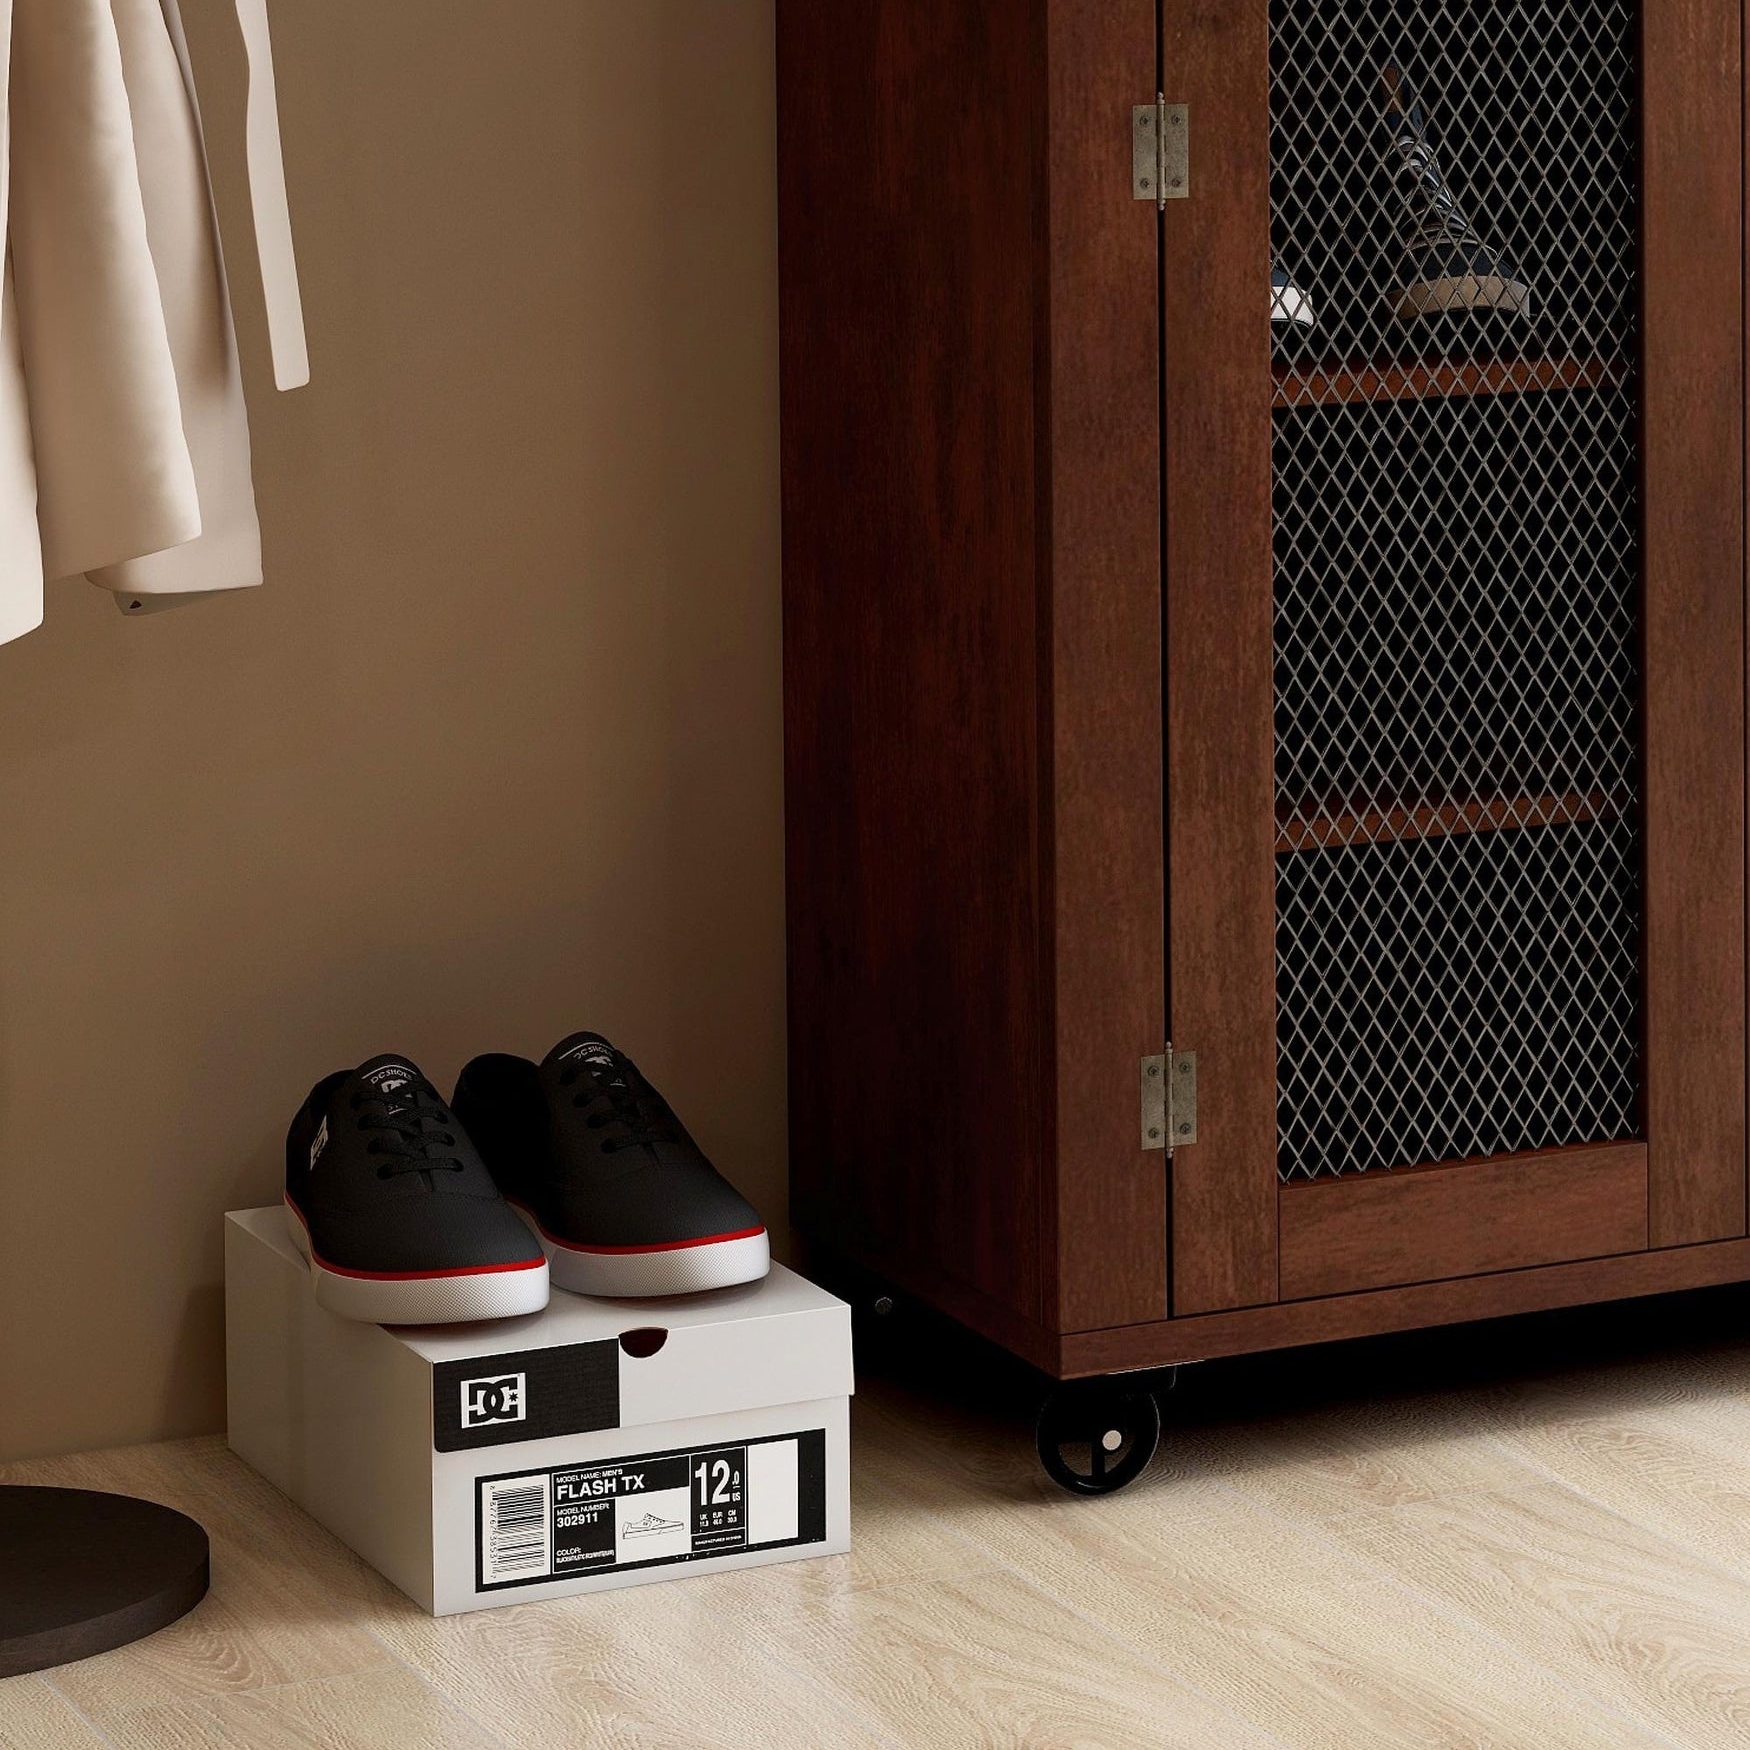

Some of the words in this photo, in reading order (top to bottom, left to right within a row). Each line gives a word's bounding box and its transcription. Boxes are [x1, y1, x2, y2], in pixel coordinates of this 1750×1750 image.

[468, 1376, 519, 1425] DC
[556, 1475, 580, 1484] MODEL
[556, 1477, 617, 1501] FLASH
[621, 1473, 646, 1491] TX
[694, 1459, 731, 1507] 12
[731, 1491, 741, 1502] US
[556, 1506, 580, 1516] MODEL
[556, 1511, 599, 1528] 302911
